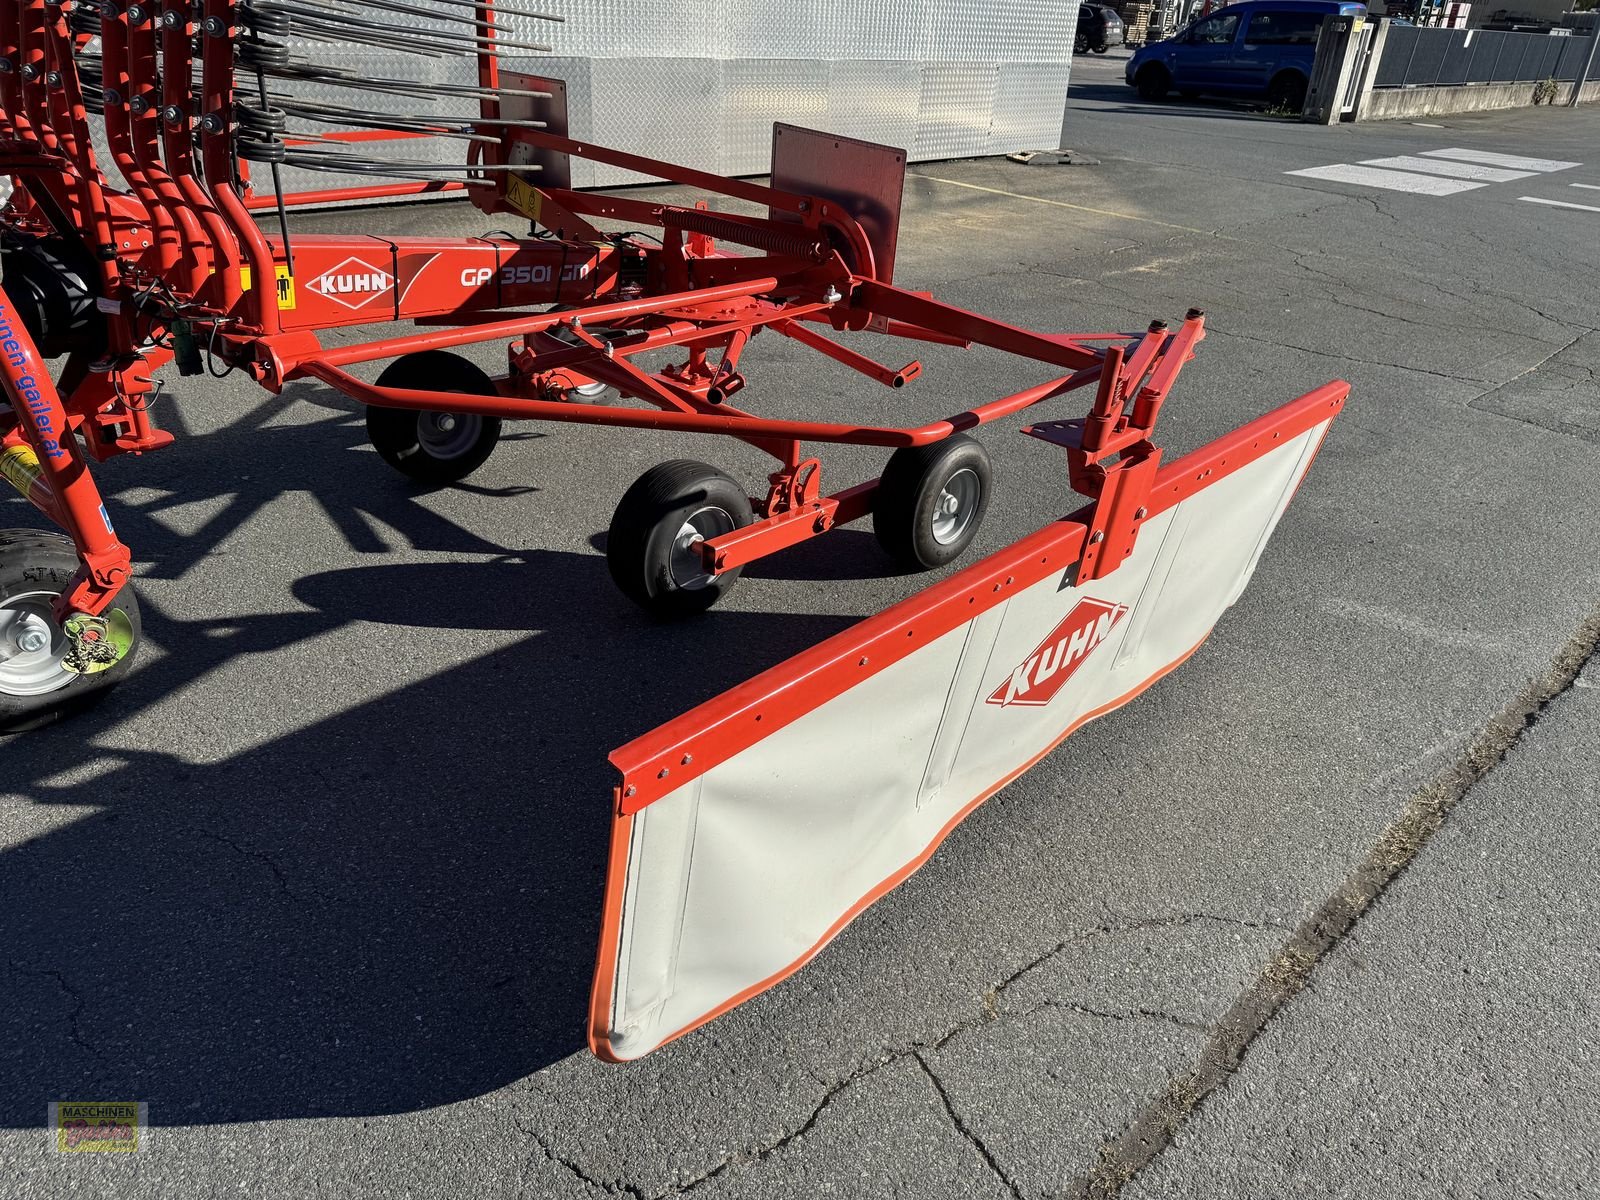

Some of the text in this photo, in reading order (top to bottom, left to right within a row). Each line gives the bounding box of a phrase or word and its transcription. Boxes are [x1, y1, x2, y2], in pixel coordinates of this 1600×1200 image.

[321, 273, 387, 294] KUHN
[461, 264, 589, 286] GA 3501 GM
[0, 305, 64, 458] inen-gailer.at
[1001, 603, 1121, 708] KUHN
